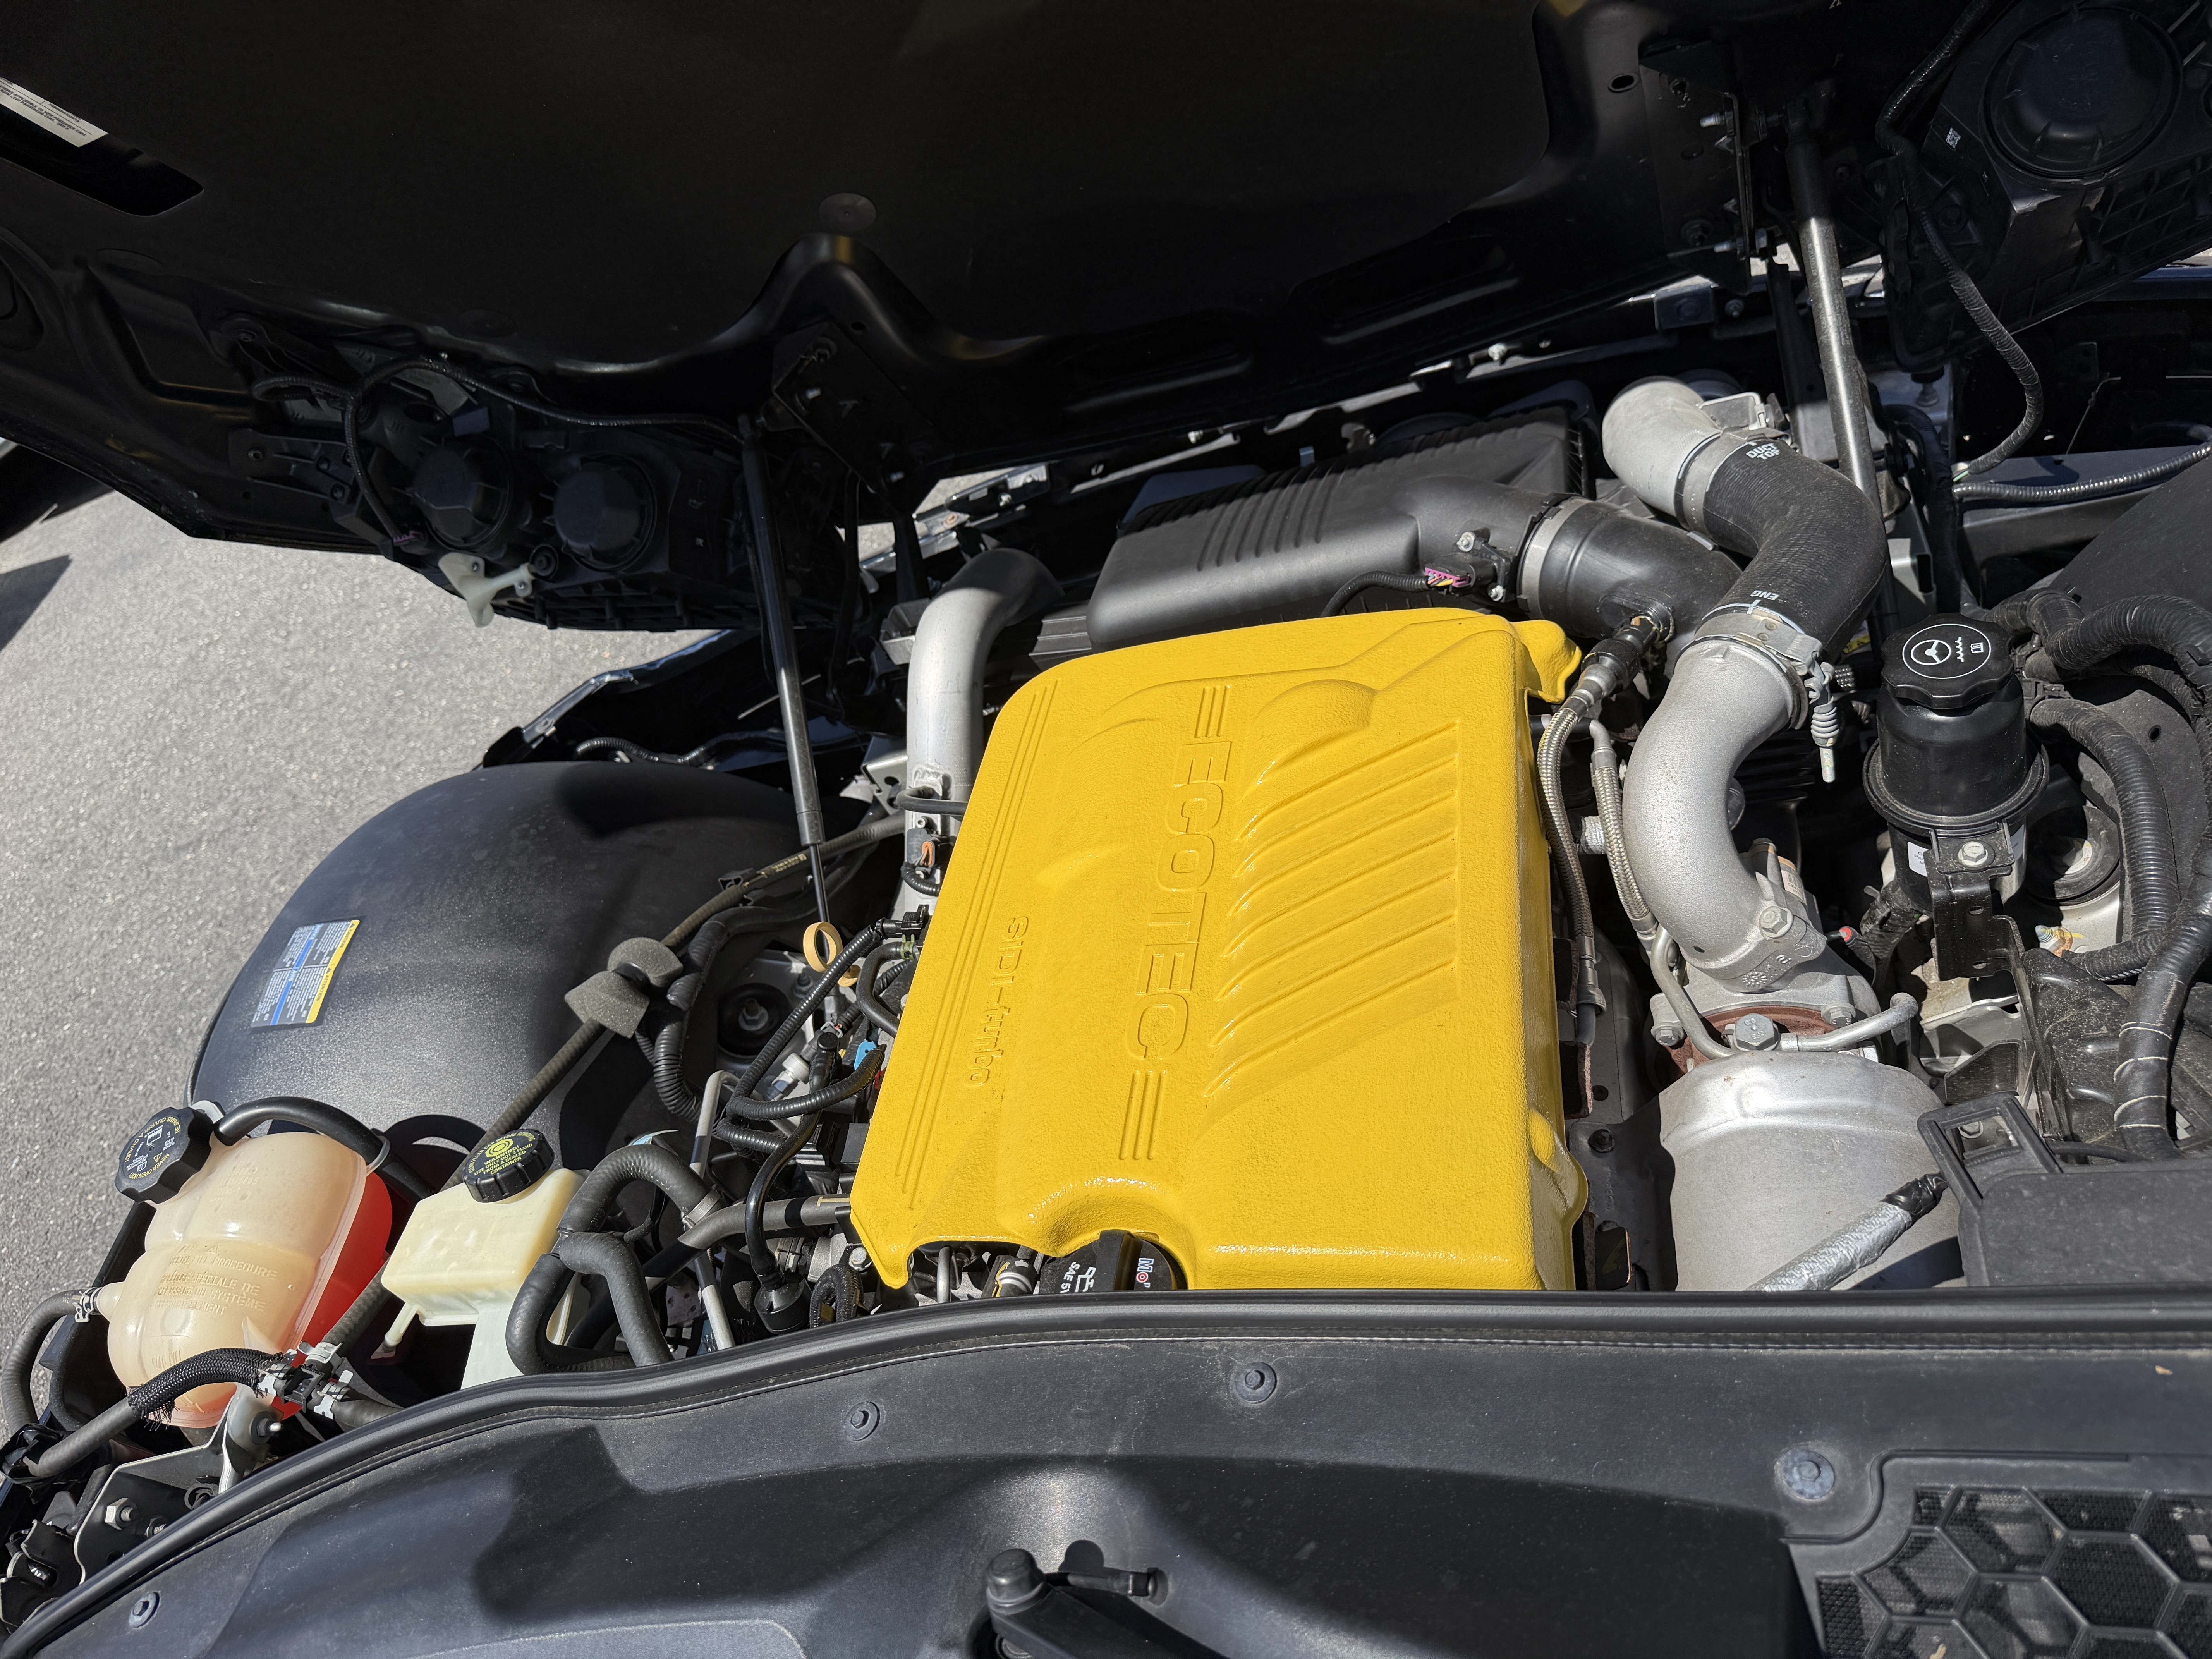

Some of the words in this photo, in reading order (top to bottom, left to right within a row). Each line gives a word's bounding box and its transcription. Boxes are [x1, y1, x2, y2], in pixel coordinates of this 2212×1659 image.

[1750, 590, 1779, 601] ENG
[1126, 741, 1233, 1060] ECOTEC
[484, 1141, 495, 1150] CAP
[496, 1132, 517, 1142] BEFORE
[153, 1153, 170, 1171] NEVER
[474, 1167, 484, 1176] USE
[486, 1159, 500, 1169] ONLY
[517, 1143, 533, 1152] FLUID
[483, 1165, 500, 1175] FROM
[505, 1150, 526, 1162] SEALED
[484, 1144, 520, 1166] WARNING!
[138, 1169, 152, 1179] OPEN
[490, 1156, 522, 1175] CONTAINER
[213, 1254, 278, 1280] PROCEDURE
[1063, 1262, 1080, 1281] SAE
[242, 1283, 261, 1296] DE
